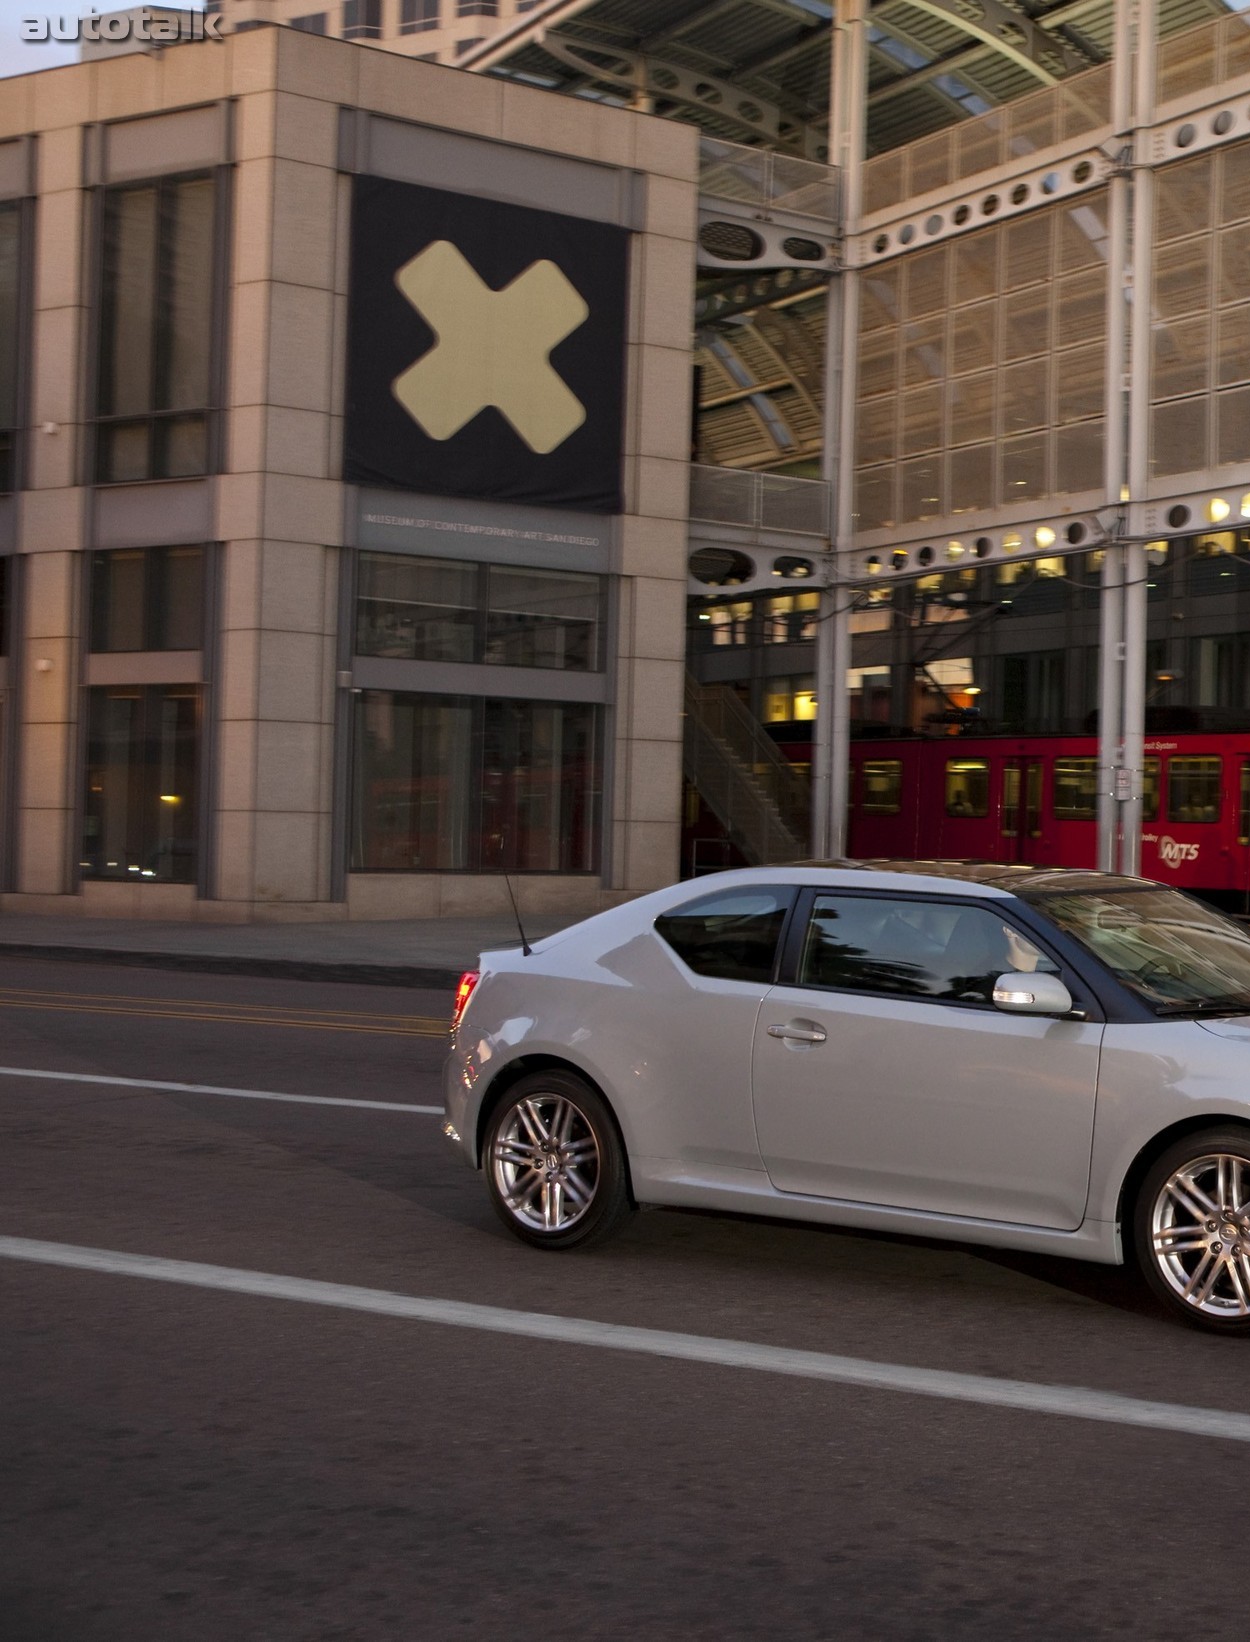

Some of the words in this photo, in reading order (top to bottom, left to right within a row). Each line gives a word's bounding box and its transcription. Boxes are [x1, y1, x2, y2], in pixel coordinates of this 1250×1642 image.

[364, 514, 413, 526] MUSEUM
[434, 521, 519, 537] CONTEMPORARY
[522, 531, 542, 541] ART
[545, 533, 565, 543] SAN
[566, 535, 600, 547] DIEGO
[1155, 741, 1178, 751] System
[1141, 833, 1158, 843] rolley
[1161, 843, 1200, 860] MTS
